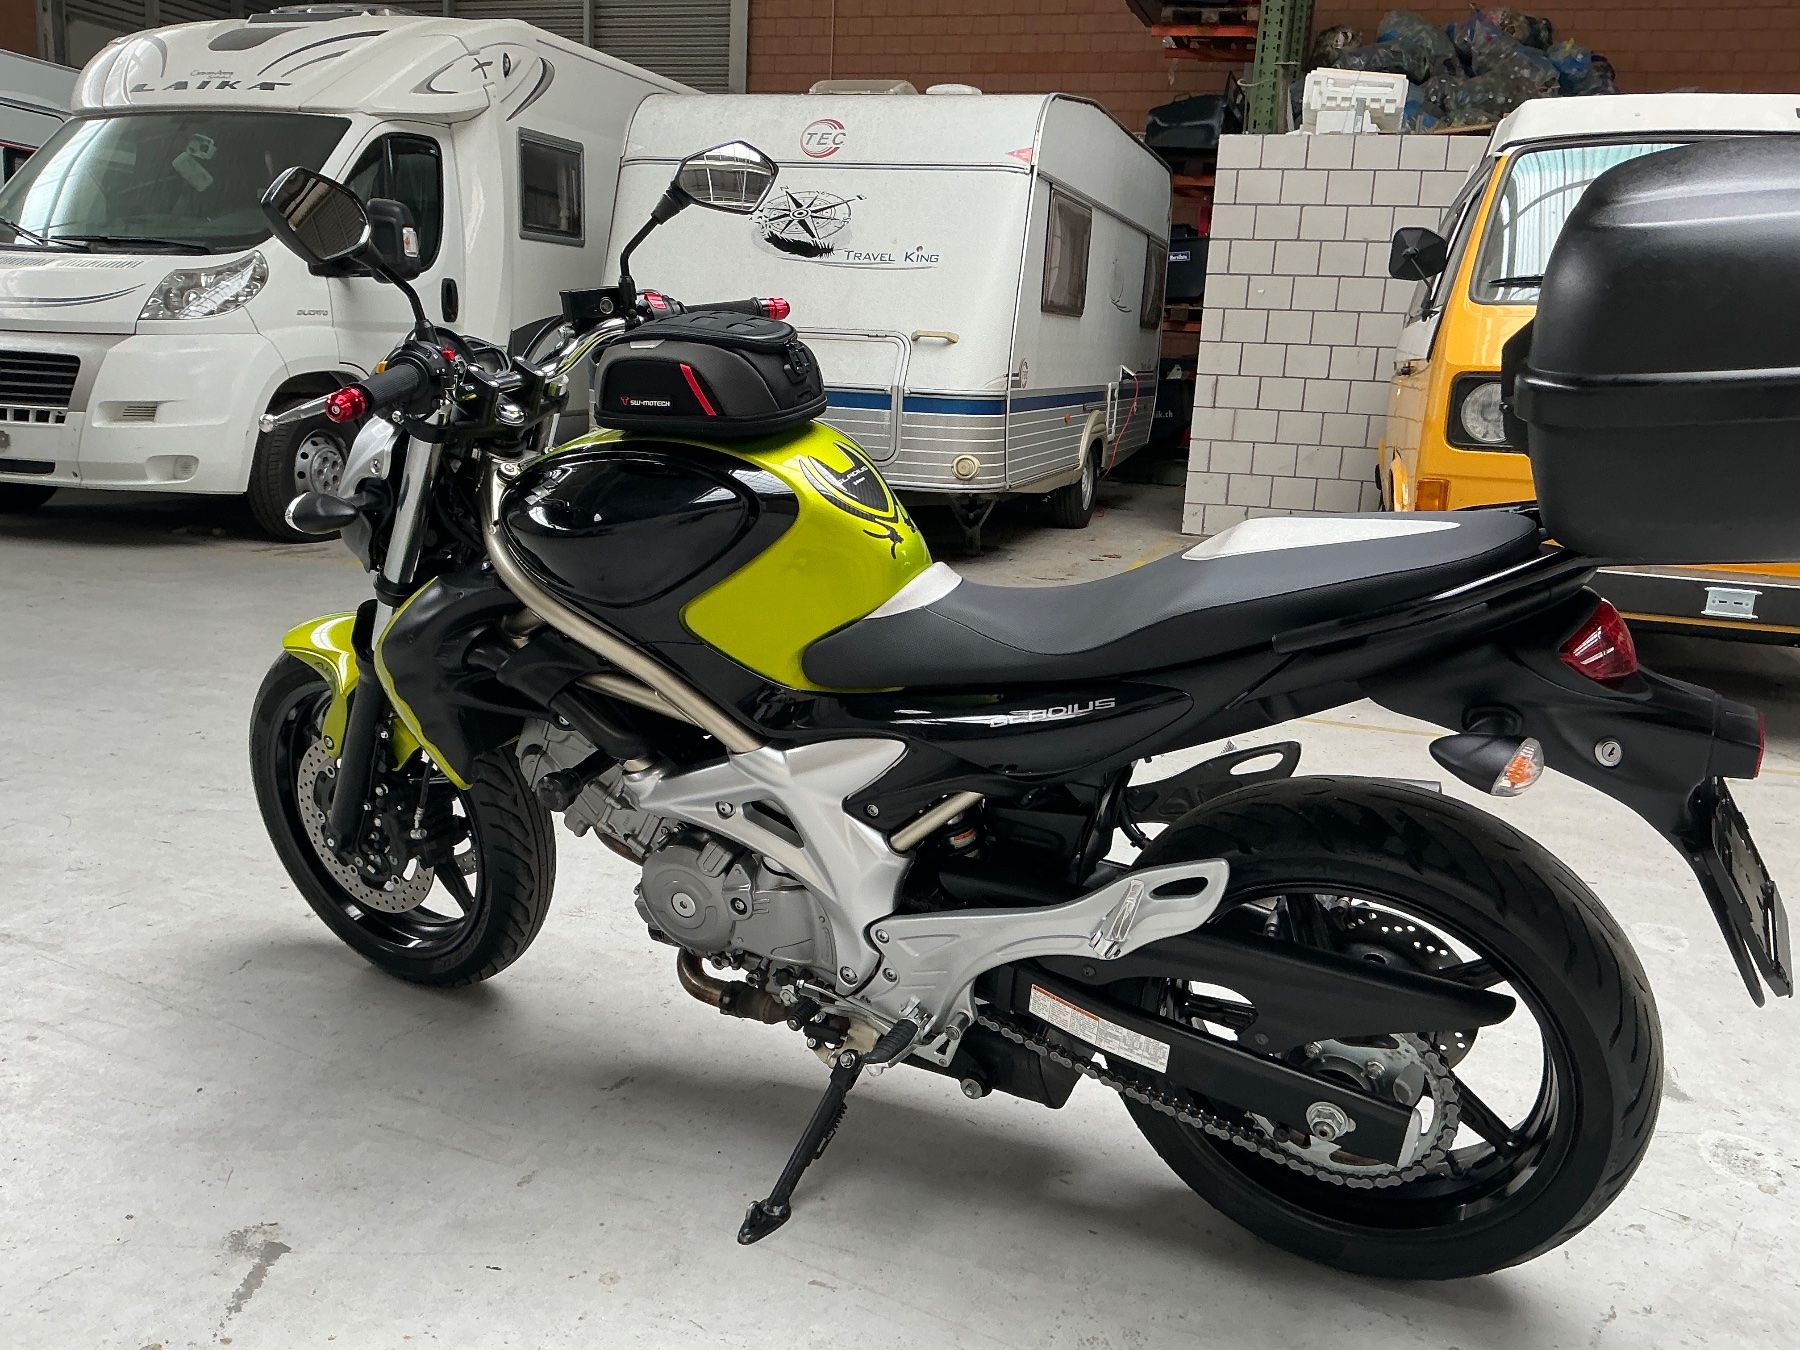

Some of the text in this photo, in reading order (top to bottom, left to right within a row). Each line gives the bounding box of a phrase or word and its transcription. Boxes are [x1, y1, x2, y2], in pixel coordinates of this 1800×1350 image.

[129, 80, 292, 93] LAIKA
[805, 132, 847, 146] TEC
[844, 250, 896, 262] TRAVEL
[630, 399, 671, 407] SW-MOTECH
